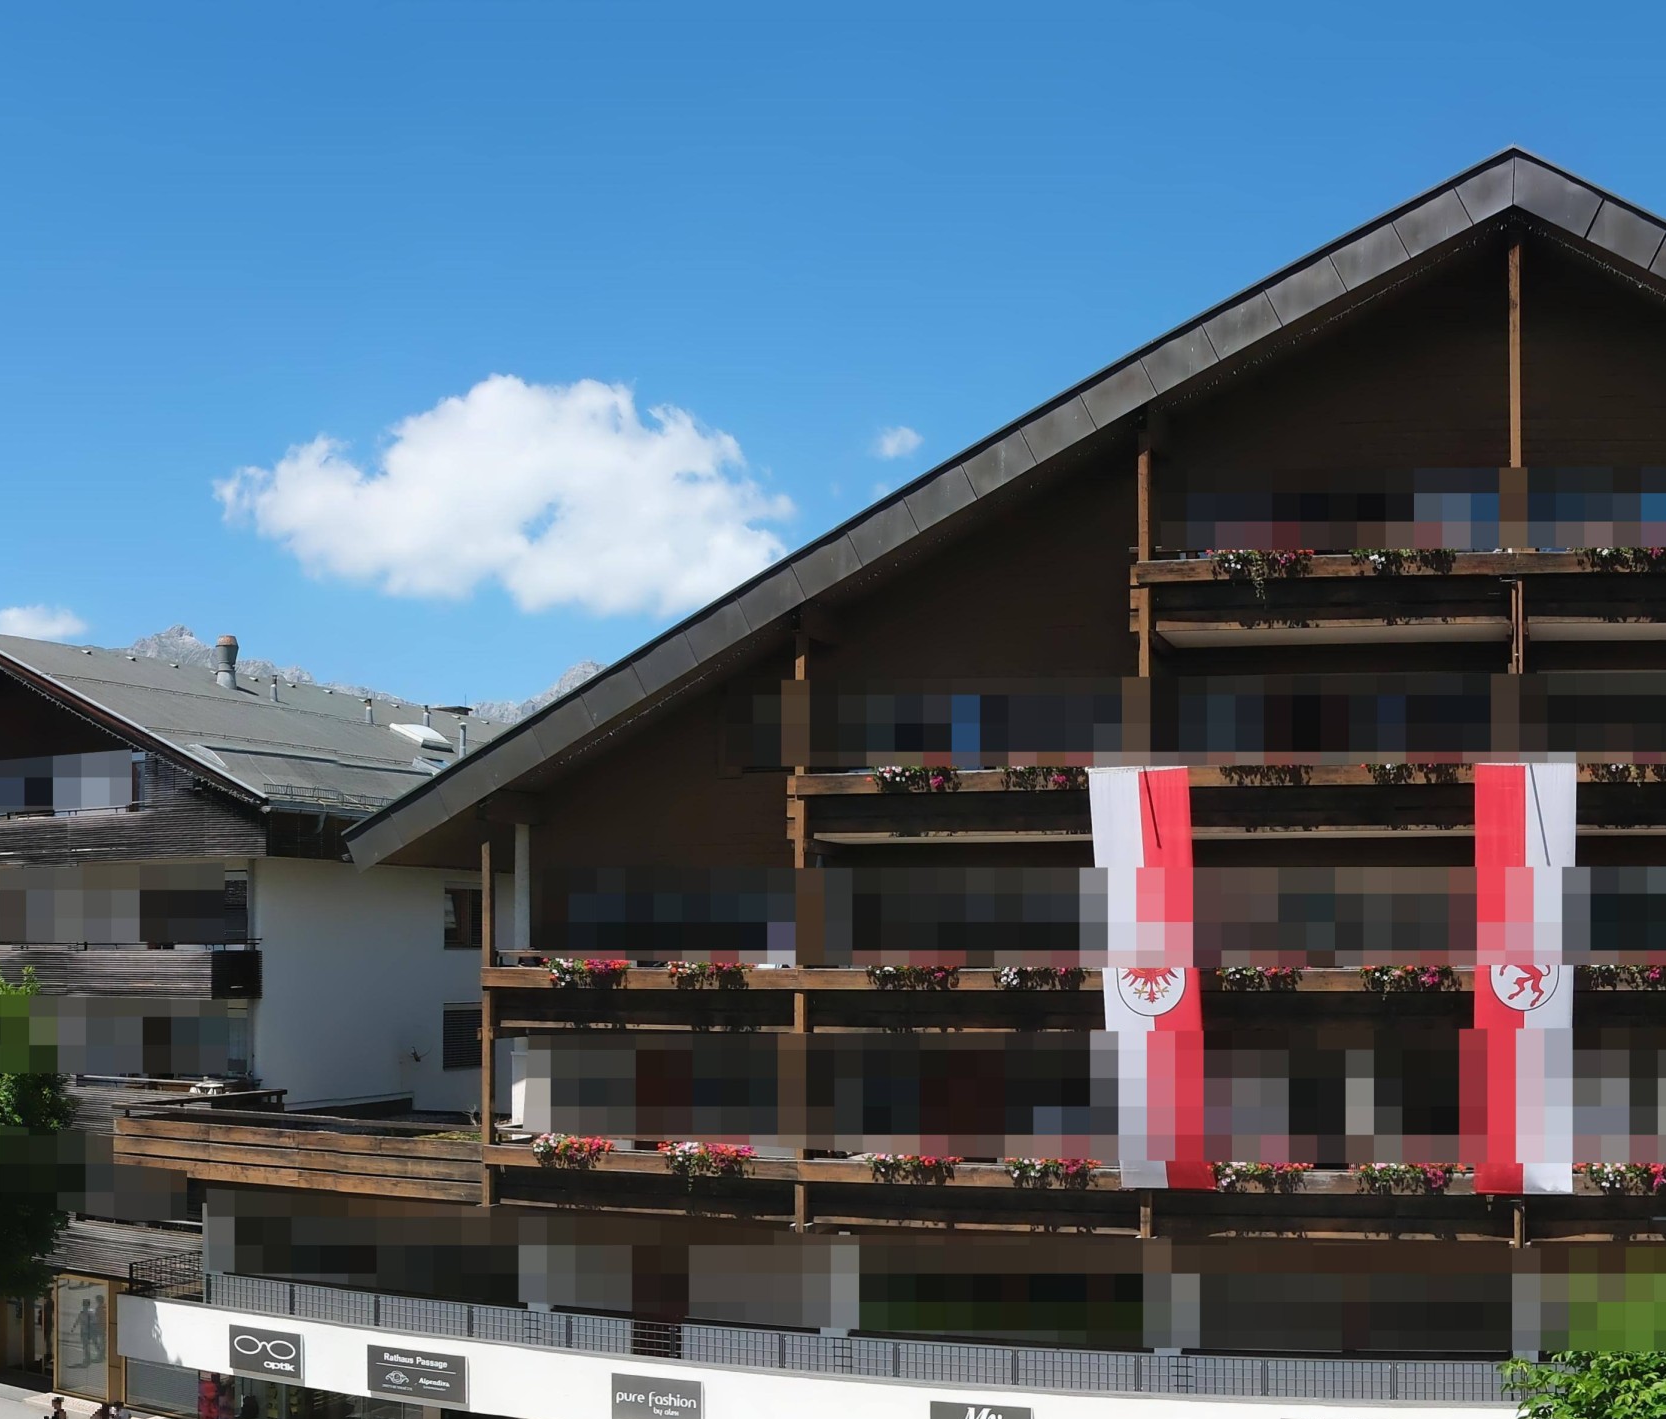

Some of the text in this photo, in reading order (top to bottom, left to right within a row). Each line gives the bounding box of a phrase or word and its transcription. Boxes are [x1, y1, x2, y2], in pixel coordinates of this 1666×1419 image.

[263, 1360, 296, 1372] optik
[383, 1352, 448, 1369] Rathaus Passage
[616, 1391, 697, 1409] pure fashion
[653, 1406, 663, 1416] by
